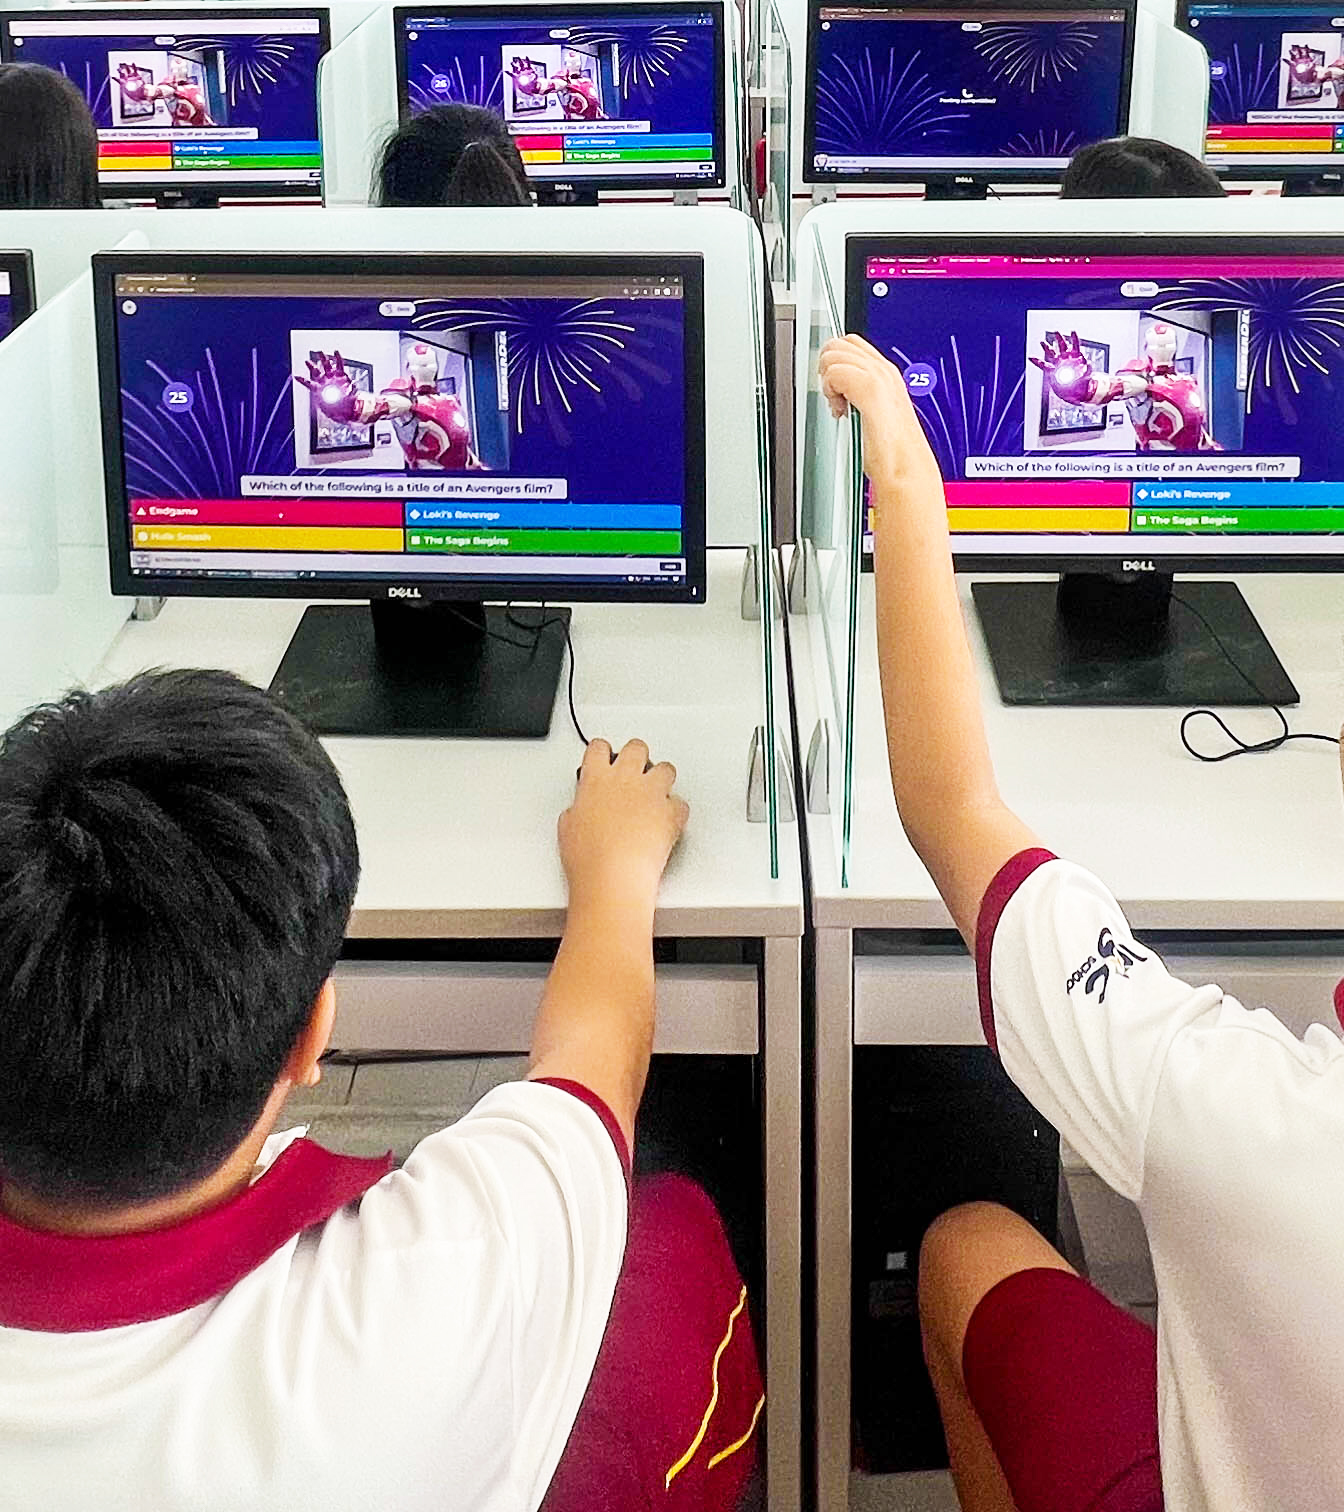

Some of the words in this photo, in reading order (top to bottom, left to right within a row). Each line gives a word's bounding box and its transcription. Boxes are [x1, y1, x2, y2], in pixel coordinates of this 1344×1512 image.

[909, 373, 931, 387] 25
[169, 390, 188, 405] 25
[974, 461, 1014, 473] Which
[1016, 461, 1029, 473] of
[1031, 461, 1052, 473] the
[1054, 461, 1110, 475] following
[1113, 461, 1123, 473] is
[1125, 463, 1134, 473] a
[1136, 461, 1160, 473] title
[1162, 461, 1175, 473] of
[1177, 463, 1193, 473] an
[1195, 461, 1253, 474] Avengers
[1255, 461, 1285, 473] film?
[248, 481, 288, 491] Which
[289, 481, 302, 492] of
[304, 482, 325, 492] the
[326, 482, 382, 495] following
[384, 482, 395, 493] is
[396, 484, 405, 493] a
[406, 482, 430, 493] title
[432, 482, 445, 493] of
[446, 485, 463, 494] an
[465, 483, 521, 496] Avengers
[523, 482, 553, 494] film?
[1150, 489, 1183, 499] Loki's
[1183, 489, 1232, 502] Revenge
[148, 506, 199, 518] Endgame
[422, 509, 453, 520] Loki's
[454, 509, 501, 522] Revenge
[1149, 515, 1171, 526] The
[1171, 515, 1199, 528] Saga
[1200, 515, 1239, 528] Begins
[423, 534, 444, 546] The
[444, 535, 471, 548] Saga
[472, 535, 510, 548] Begins
[1122, 559, 1156, 572] DELL
[387, 586, 422, 599] DELL
